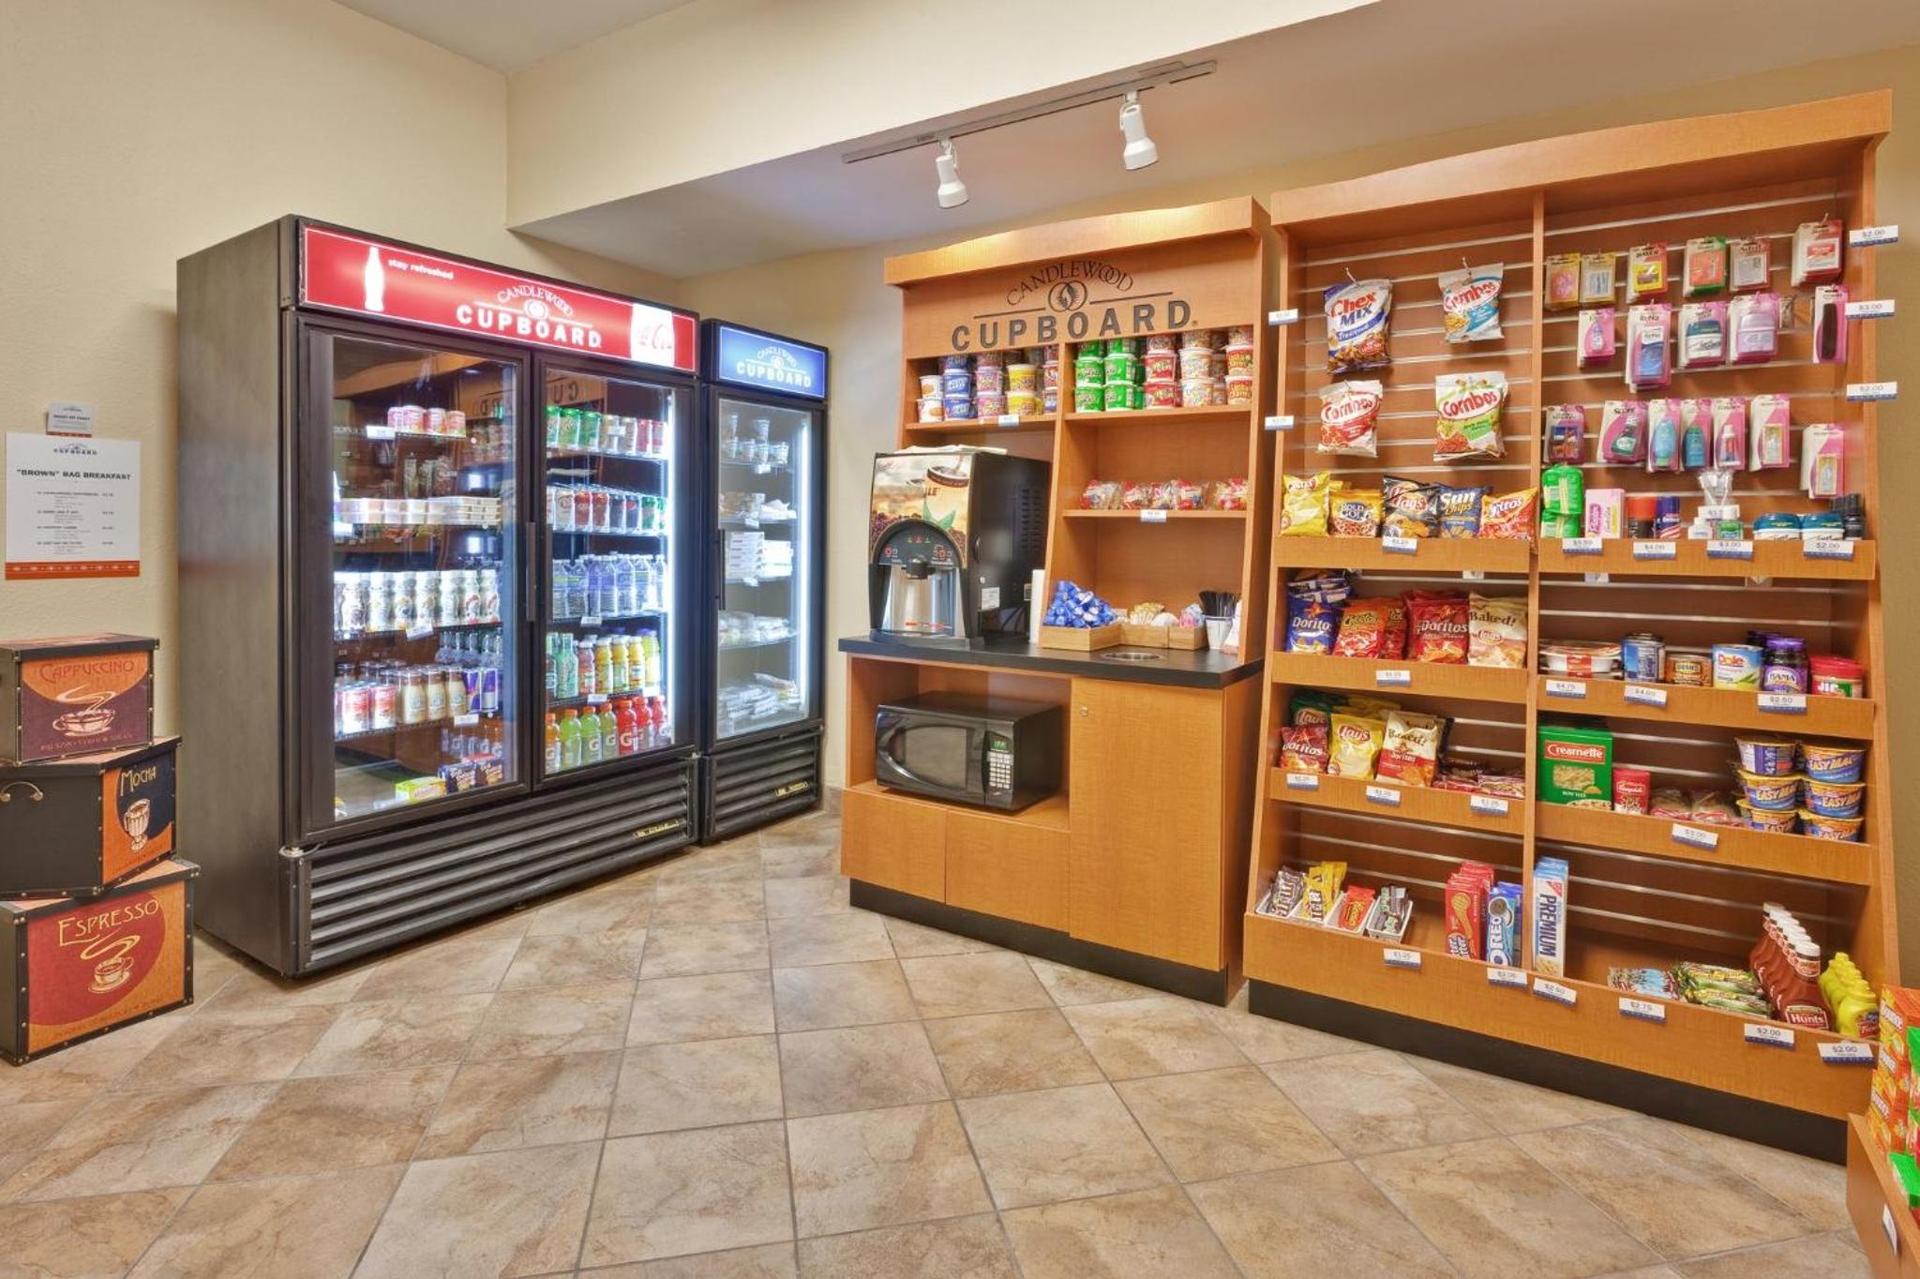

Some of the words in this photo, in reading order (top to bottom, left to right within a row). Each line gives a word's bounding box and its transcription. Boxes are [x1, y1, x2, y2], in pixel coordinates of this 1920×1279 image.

[1005, 260, 1133, 306] CANDLEWOOD
[497, 285, 575, 317] CANDLEWOOD
[1329, 291, 1377, 318] Chex
[455, 304, 602, 349] CUPBOARD
[951, 300, 1191, 351] CUPBOARD
[736, 361, 812, 388] CUPBOARD
[1442, 391, 1498, 416] Combos
[83, 472, 131, 481] BREAKFAST
[41, 660, 135, 684] CAPPUCCINO
[1547, 743, 1603, 759] Creamette
[120, 764, 157, 798] MOCHA
[58, 899, 160, 947] ESPRESSO
[1539, 893, 1557, 958] PREMIUM
